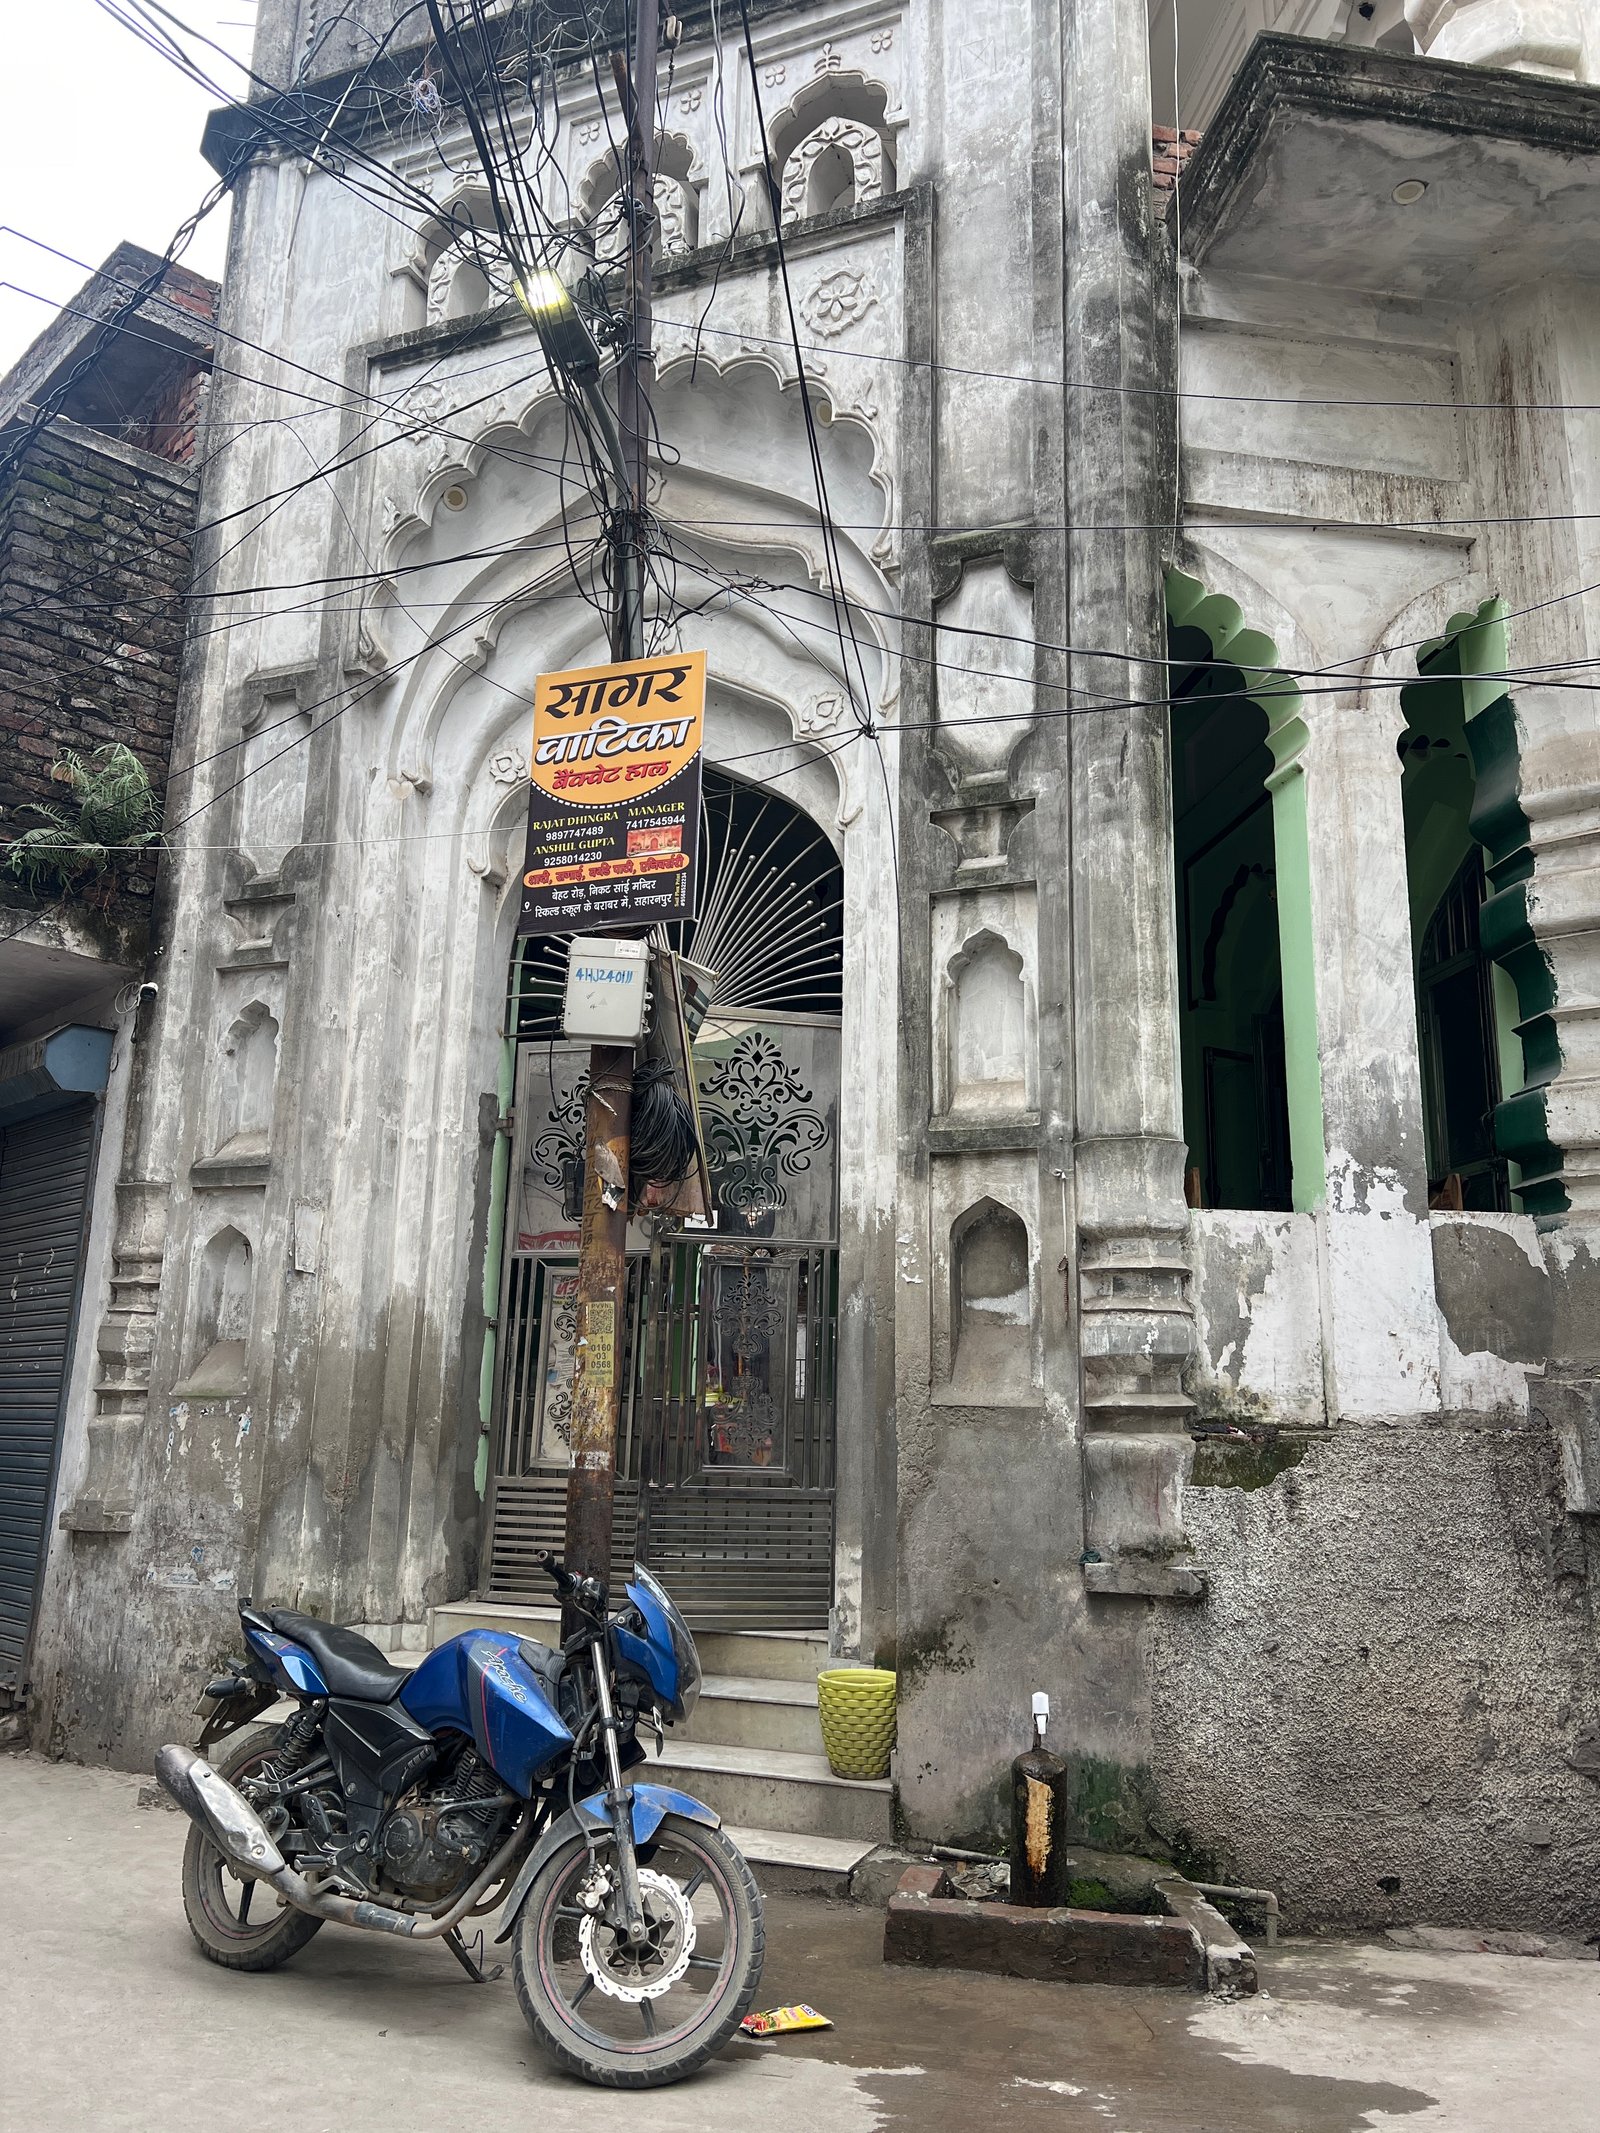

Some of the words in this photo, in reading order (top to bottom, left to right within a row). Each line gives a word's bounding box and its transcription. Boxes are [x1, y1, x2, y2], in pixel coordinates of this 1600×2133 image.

[545, 665, 692, 718] सागर
[535, 716, 696, 765] वाटिका
[626, 761, 671, 781] हाल
[628, 802, 685, 817] MANAGER
[533, 818, 565, 830] RAJAT
[567, 811, 619, 826] DHINGRA
[626, 814, 686, 830] 7417545944
[546, 826, 604, 841] 9897747489
[533, 843, 576, 855] ANSHUL
[578, 837, 615, 850] GUPTA
[544, 851, 602, 867] 9258014230
[589, 884, 611, 897] निकट
[632, 877, 657, 891] मन्दिर
[561, 904, 581, 917] स्कूल
[583, 900, 592, 912] के
[634, 893, 673, 907] सहारनपुर
[600, 1335, 604, 1343] 1
[591, 1344, 611, 1352] 0160
[591, 1361, 611, 1369] 0568
